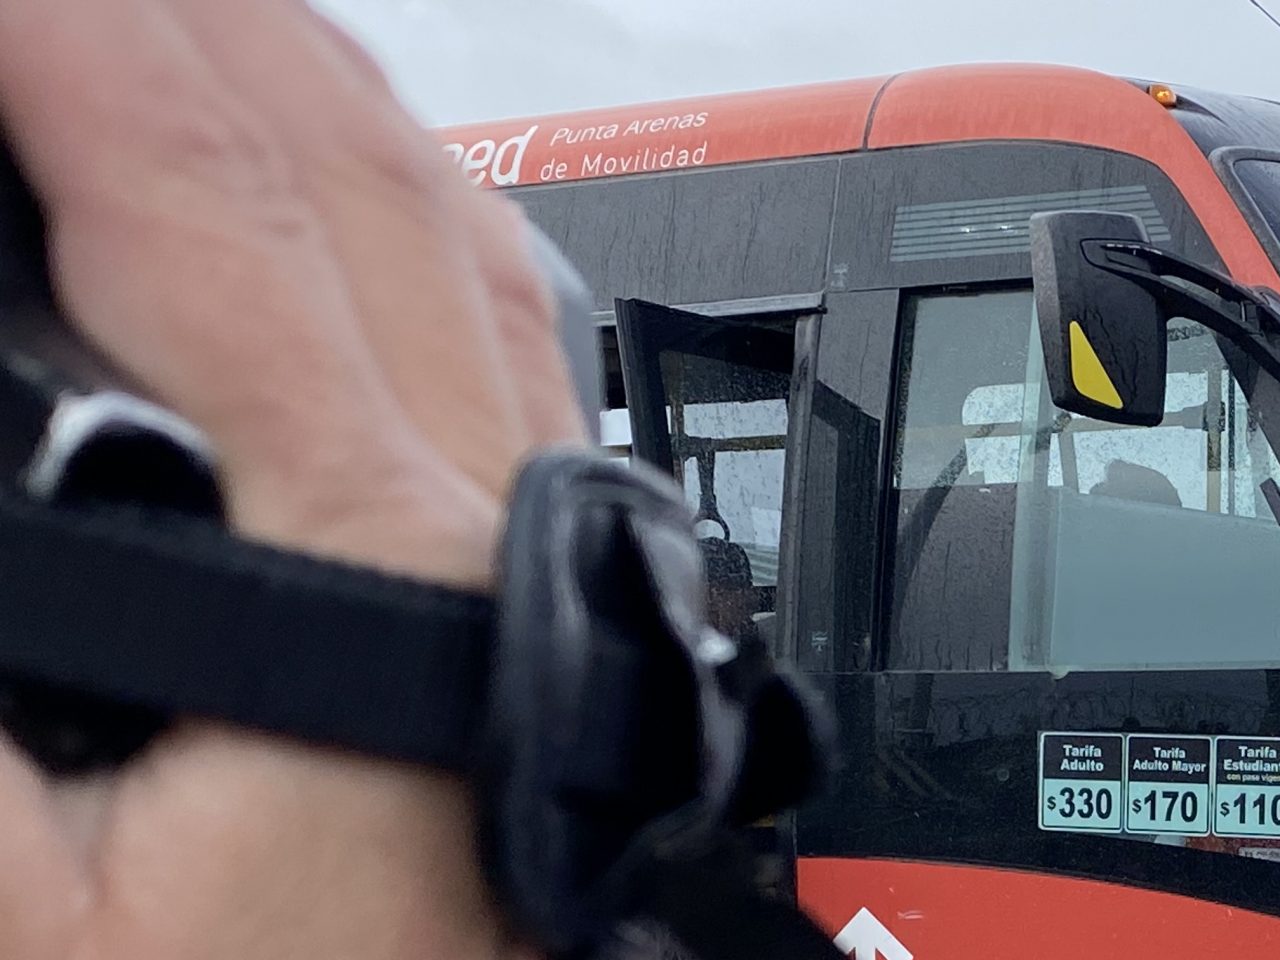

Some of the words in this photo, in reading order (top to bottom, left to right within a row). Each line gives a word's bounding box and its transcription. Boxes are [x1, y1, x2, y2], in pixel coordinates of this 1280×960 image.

[550, 123, 619, 147] Punta
[622, 111, 709, 137] Arenas
[539, 159, 568, 181] de
[580, 140, 708, 176] Movilidad
[1062, 744, 1103, 758] Tarifa
[1152, 746, 1186, 759] Tarifa
[1238, 745, 1278, 759] Tarifa
[1060, 758, 1105, 772] Adulto
[1132, 759, 1169, 771] Adulto
[1171, 760, 1207, 775] Mayor
[1226, 773, 1241, 781] con
[1047, 786, 1113, 820] $330
[1131, 789, 1198, 823] $170
